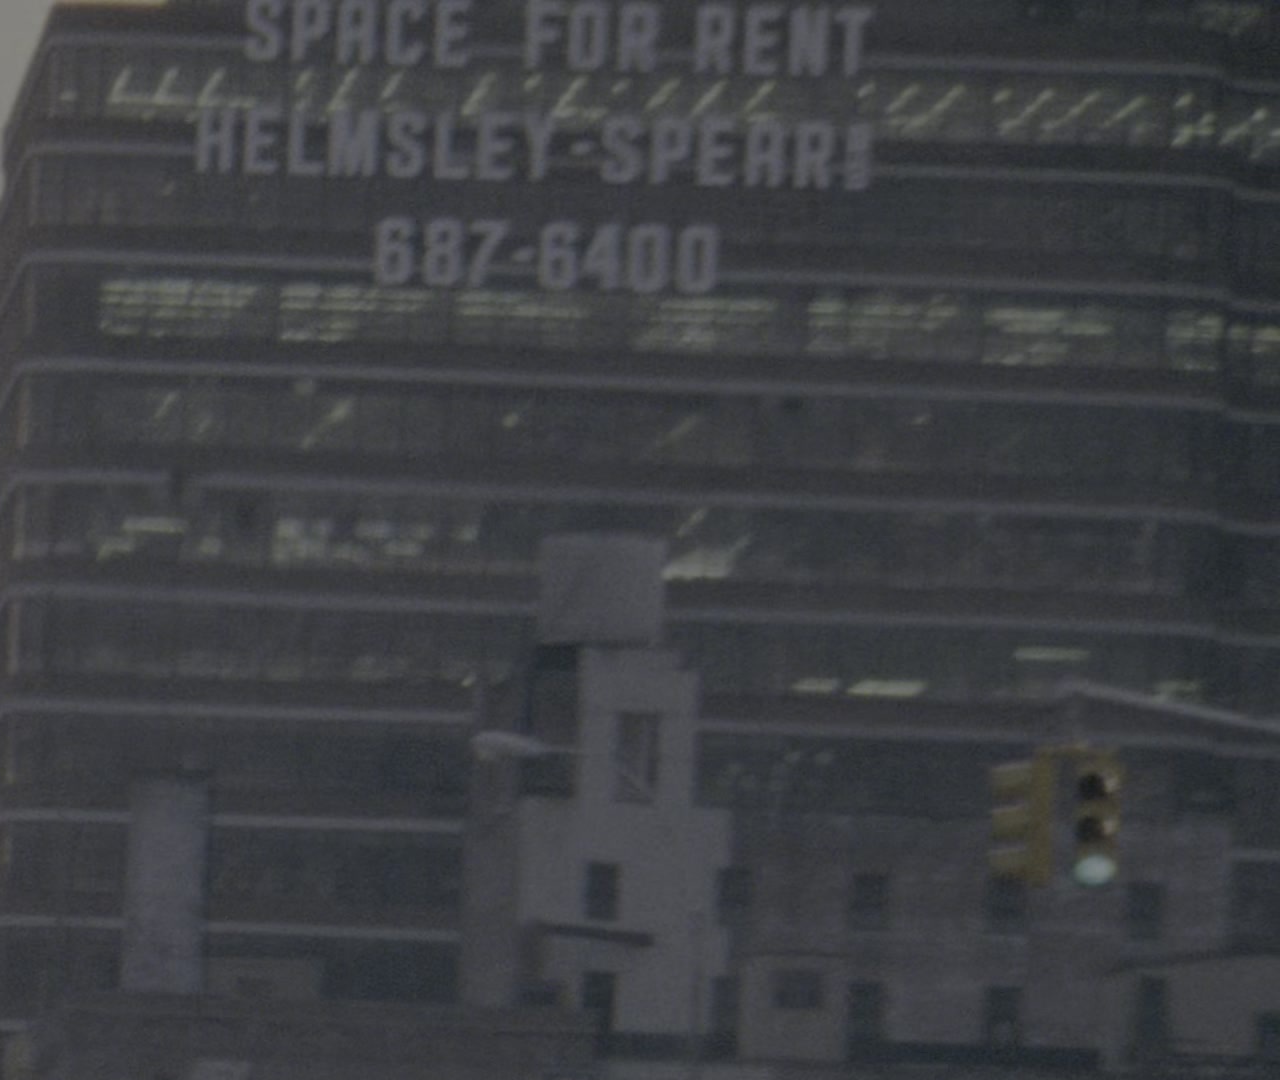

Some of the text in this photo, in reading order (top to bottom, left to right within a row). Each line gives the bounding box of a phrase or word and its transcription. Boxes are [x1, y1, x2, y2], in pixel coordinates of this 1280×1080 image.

[244, 0, 876, 77] SPACE FOR RENT
[375, 216, 721, 294] 687-6400
